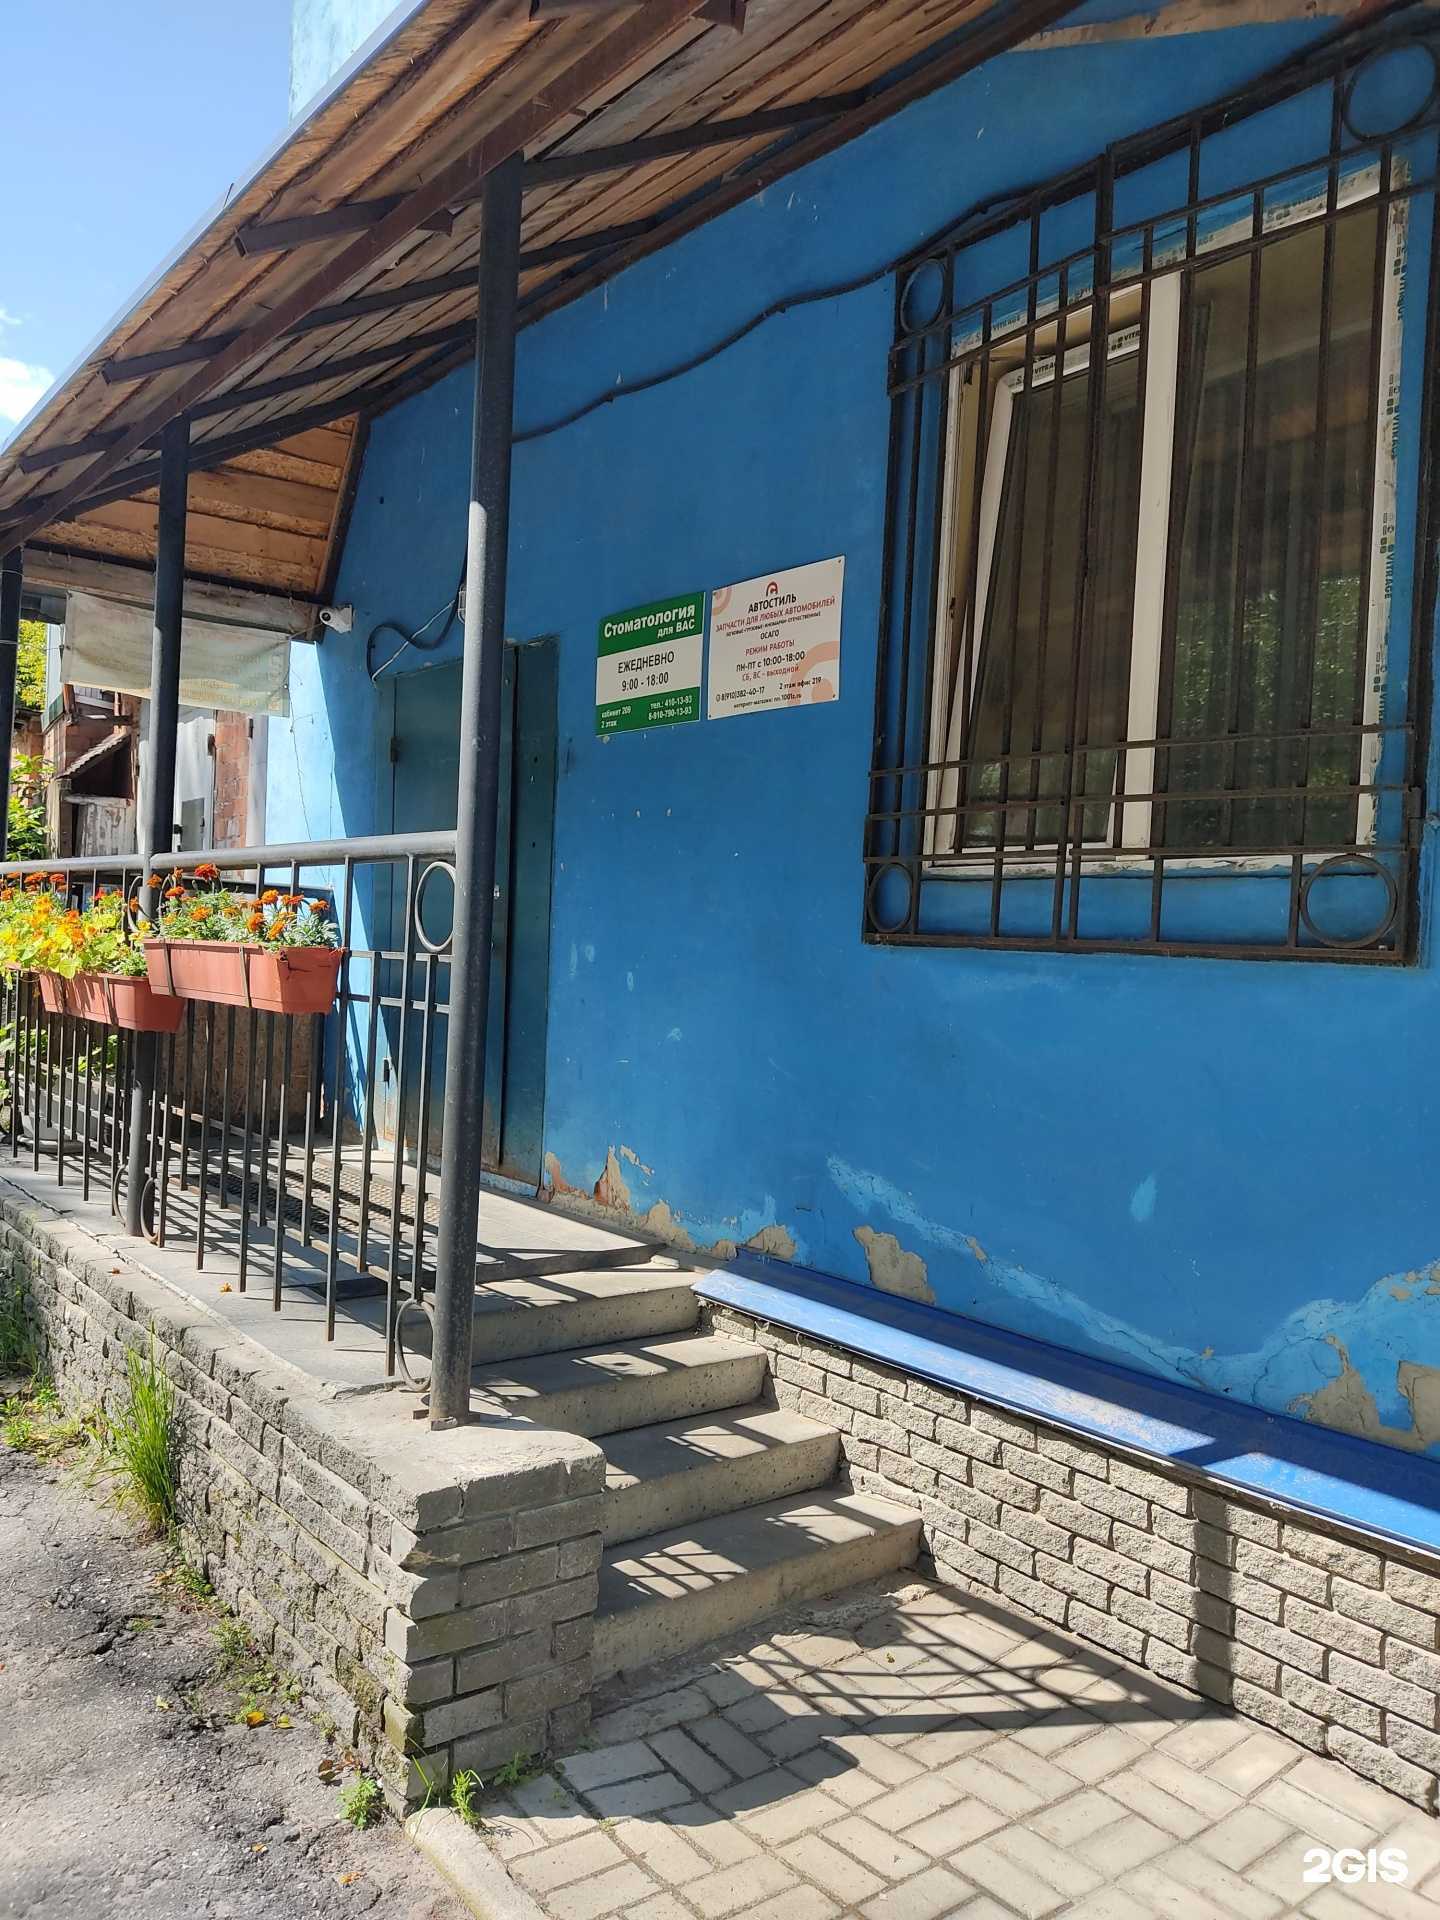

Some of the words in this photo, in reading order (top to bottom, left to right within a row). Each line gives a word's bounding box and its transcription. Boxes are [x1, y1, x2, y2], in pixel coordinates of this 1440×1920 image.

[747, 593, 797, 614] АВТОСТИЛЬ
[604, 605, 695, 638] Стоматология
[715, 618, 746, 632] ЗАПЧАСТИ
[746, 615, 759, 626] ДЛЯ
[759, 609, 784, 622] ЛЮБЫХ
[785, 596, 835, 616] АВТОМОБИЛЕЙ
[657, 626, 673, 638] для
[675, 619, 695, 633] ВАС
[760, 629, 780, 640] ОСАГО
[745, 644, 768, 656] РЕЖИМ
[769, 639, 795, 651] РАБОТЫ
[617, 651, 675, 674] ЕЖЕДНЕВНО
[736, 662, 756, 673] ПН-ПТ
[763, 650, 806, 667] 10:00-18:00
[621, 678, 639, 692] 9:00
[646, 672, 669, 687] 18:00
[753, 670, 761, 680] ВС
